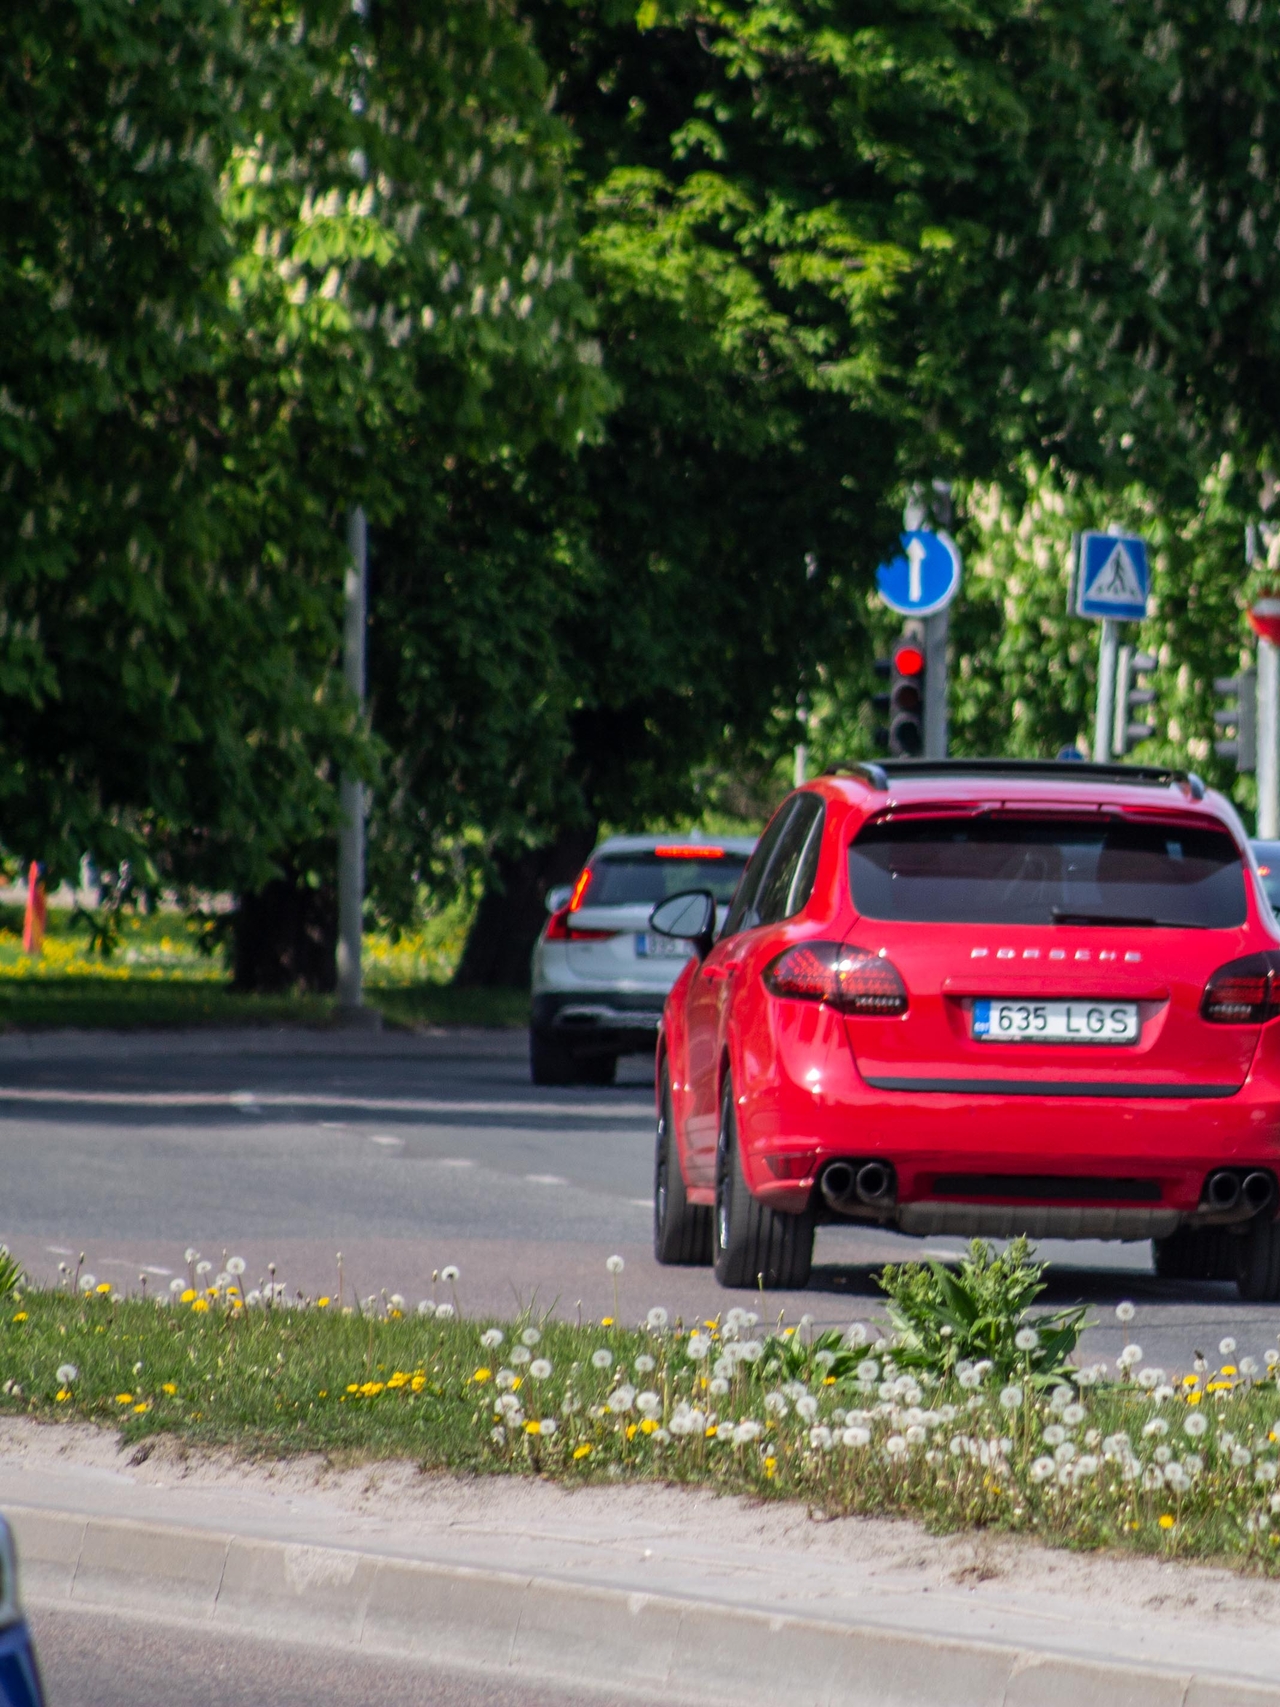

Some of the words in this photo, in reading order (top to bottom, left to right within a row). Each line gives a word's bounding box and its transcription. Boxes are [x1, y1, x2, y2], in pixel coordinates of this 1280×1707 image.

[970, 947, 1142, 963] PORSCHE
[998, 1005, 1047, 1031] 635
[1065, 1006, 1129, 1034] LGS
